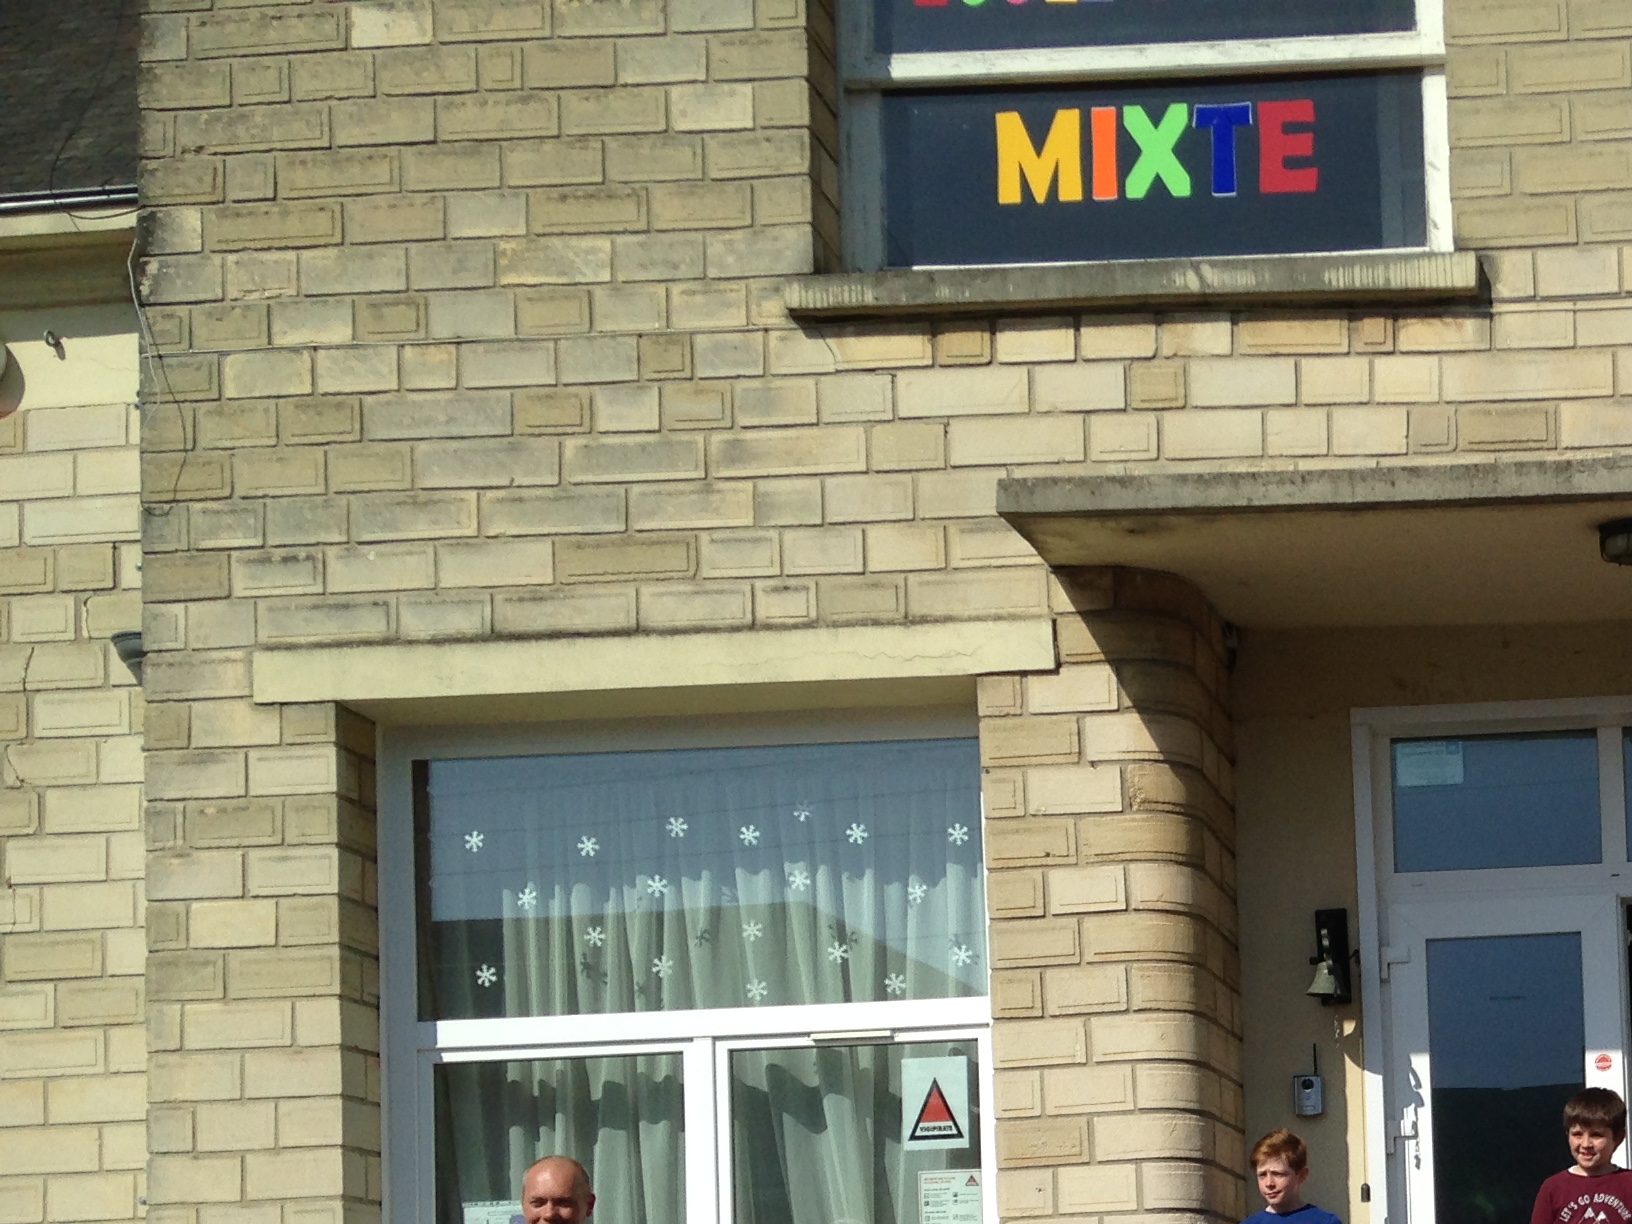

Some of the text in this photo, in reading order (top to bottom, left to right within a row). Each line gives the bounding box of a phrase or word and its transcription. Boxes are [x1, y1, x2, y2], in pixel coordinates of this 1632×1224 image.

[995, 99, 1318, 205] MIXTE
[1559, 1193, 1632, 1223] LET'S GO ADVENTURE
